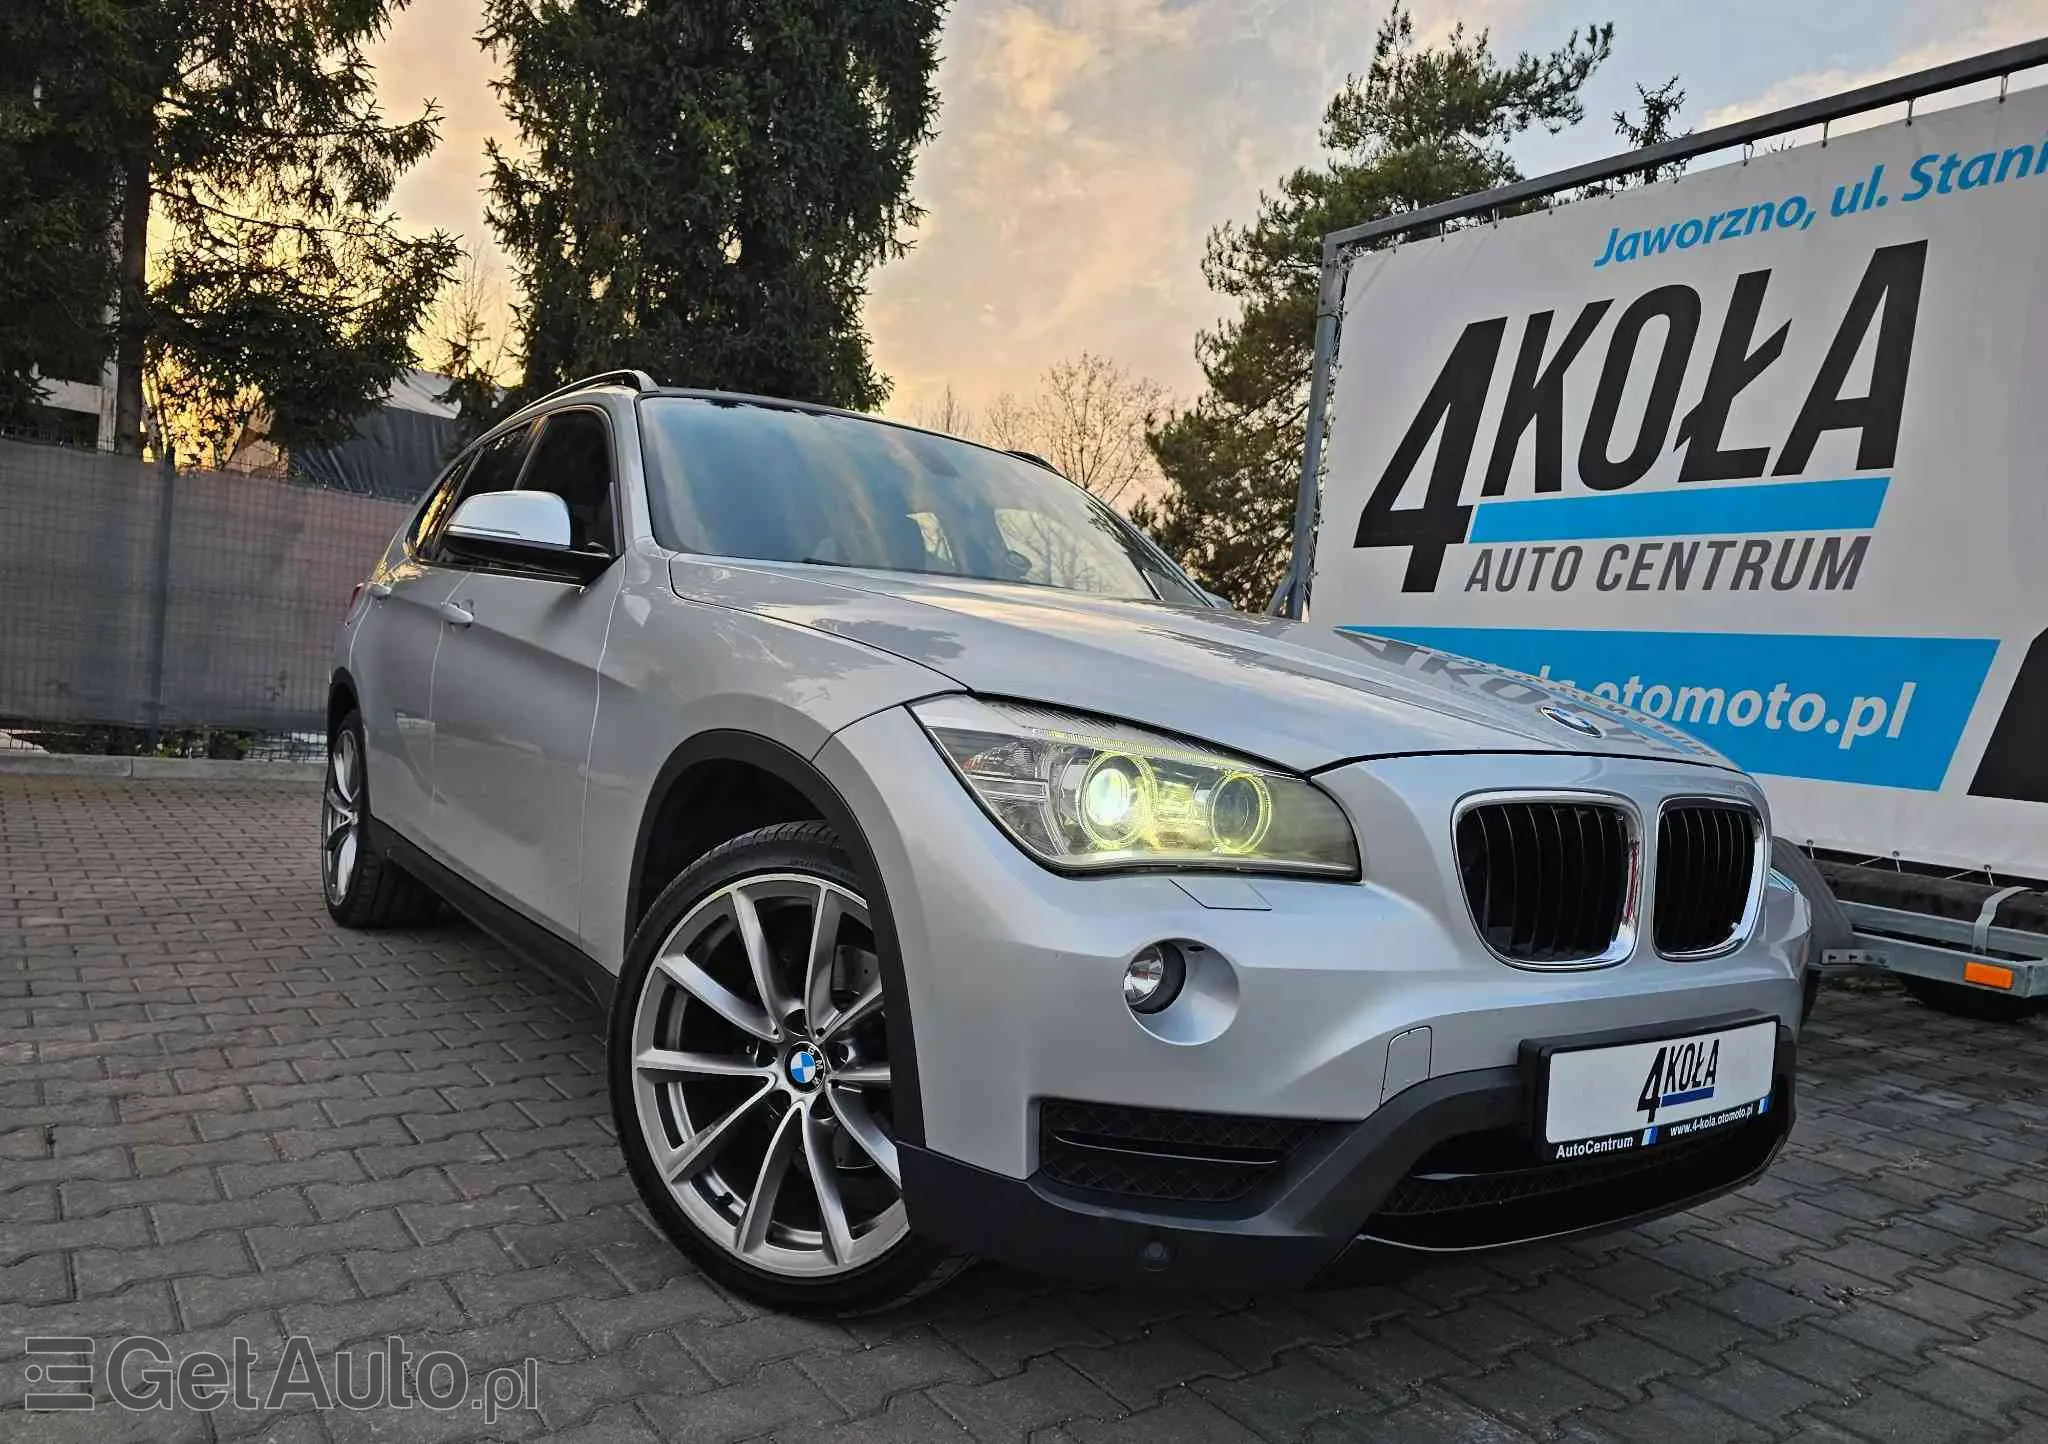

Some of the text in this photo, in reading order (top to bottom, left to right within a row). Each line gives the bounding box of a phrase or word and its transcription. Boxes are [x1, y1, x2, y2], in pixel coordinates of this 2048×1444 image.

[1593, 195, 1816, 268] Jaworzno,
[1830, 163, 1889, 218] ul.
[1464, 536, 1872, 593] AUTO CENTRUM
[1555, 1104, 1754, 1160] AutoCentrum www.4-kola.otomoto.pl
